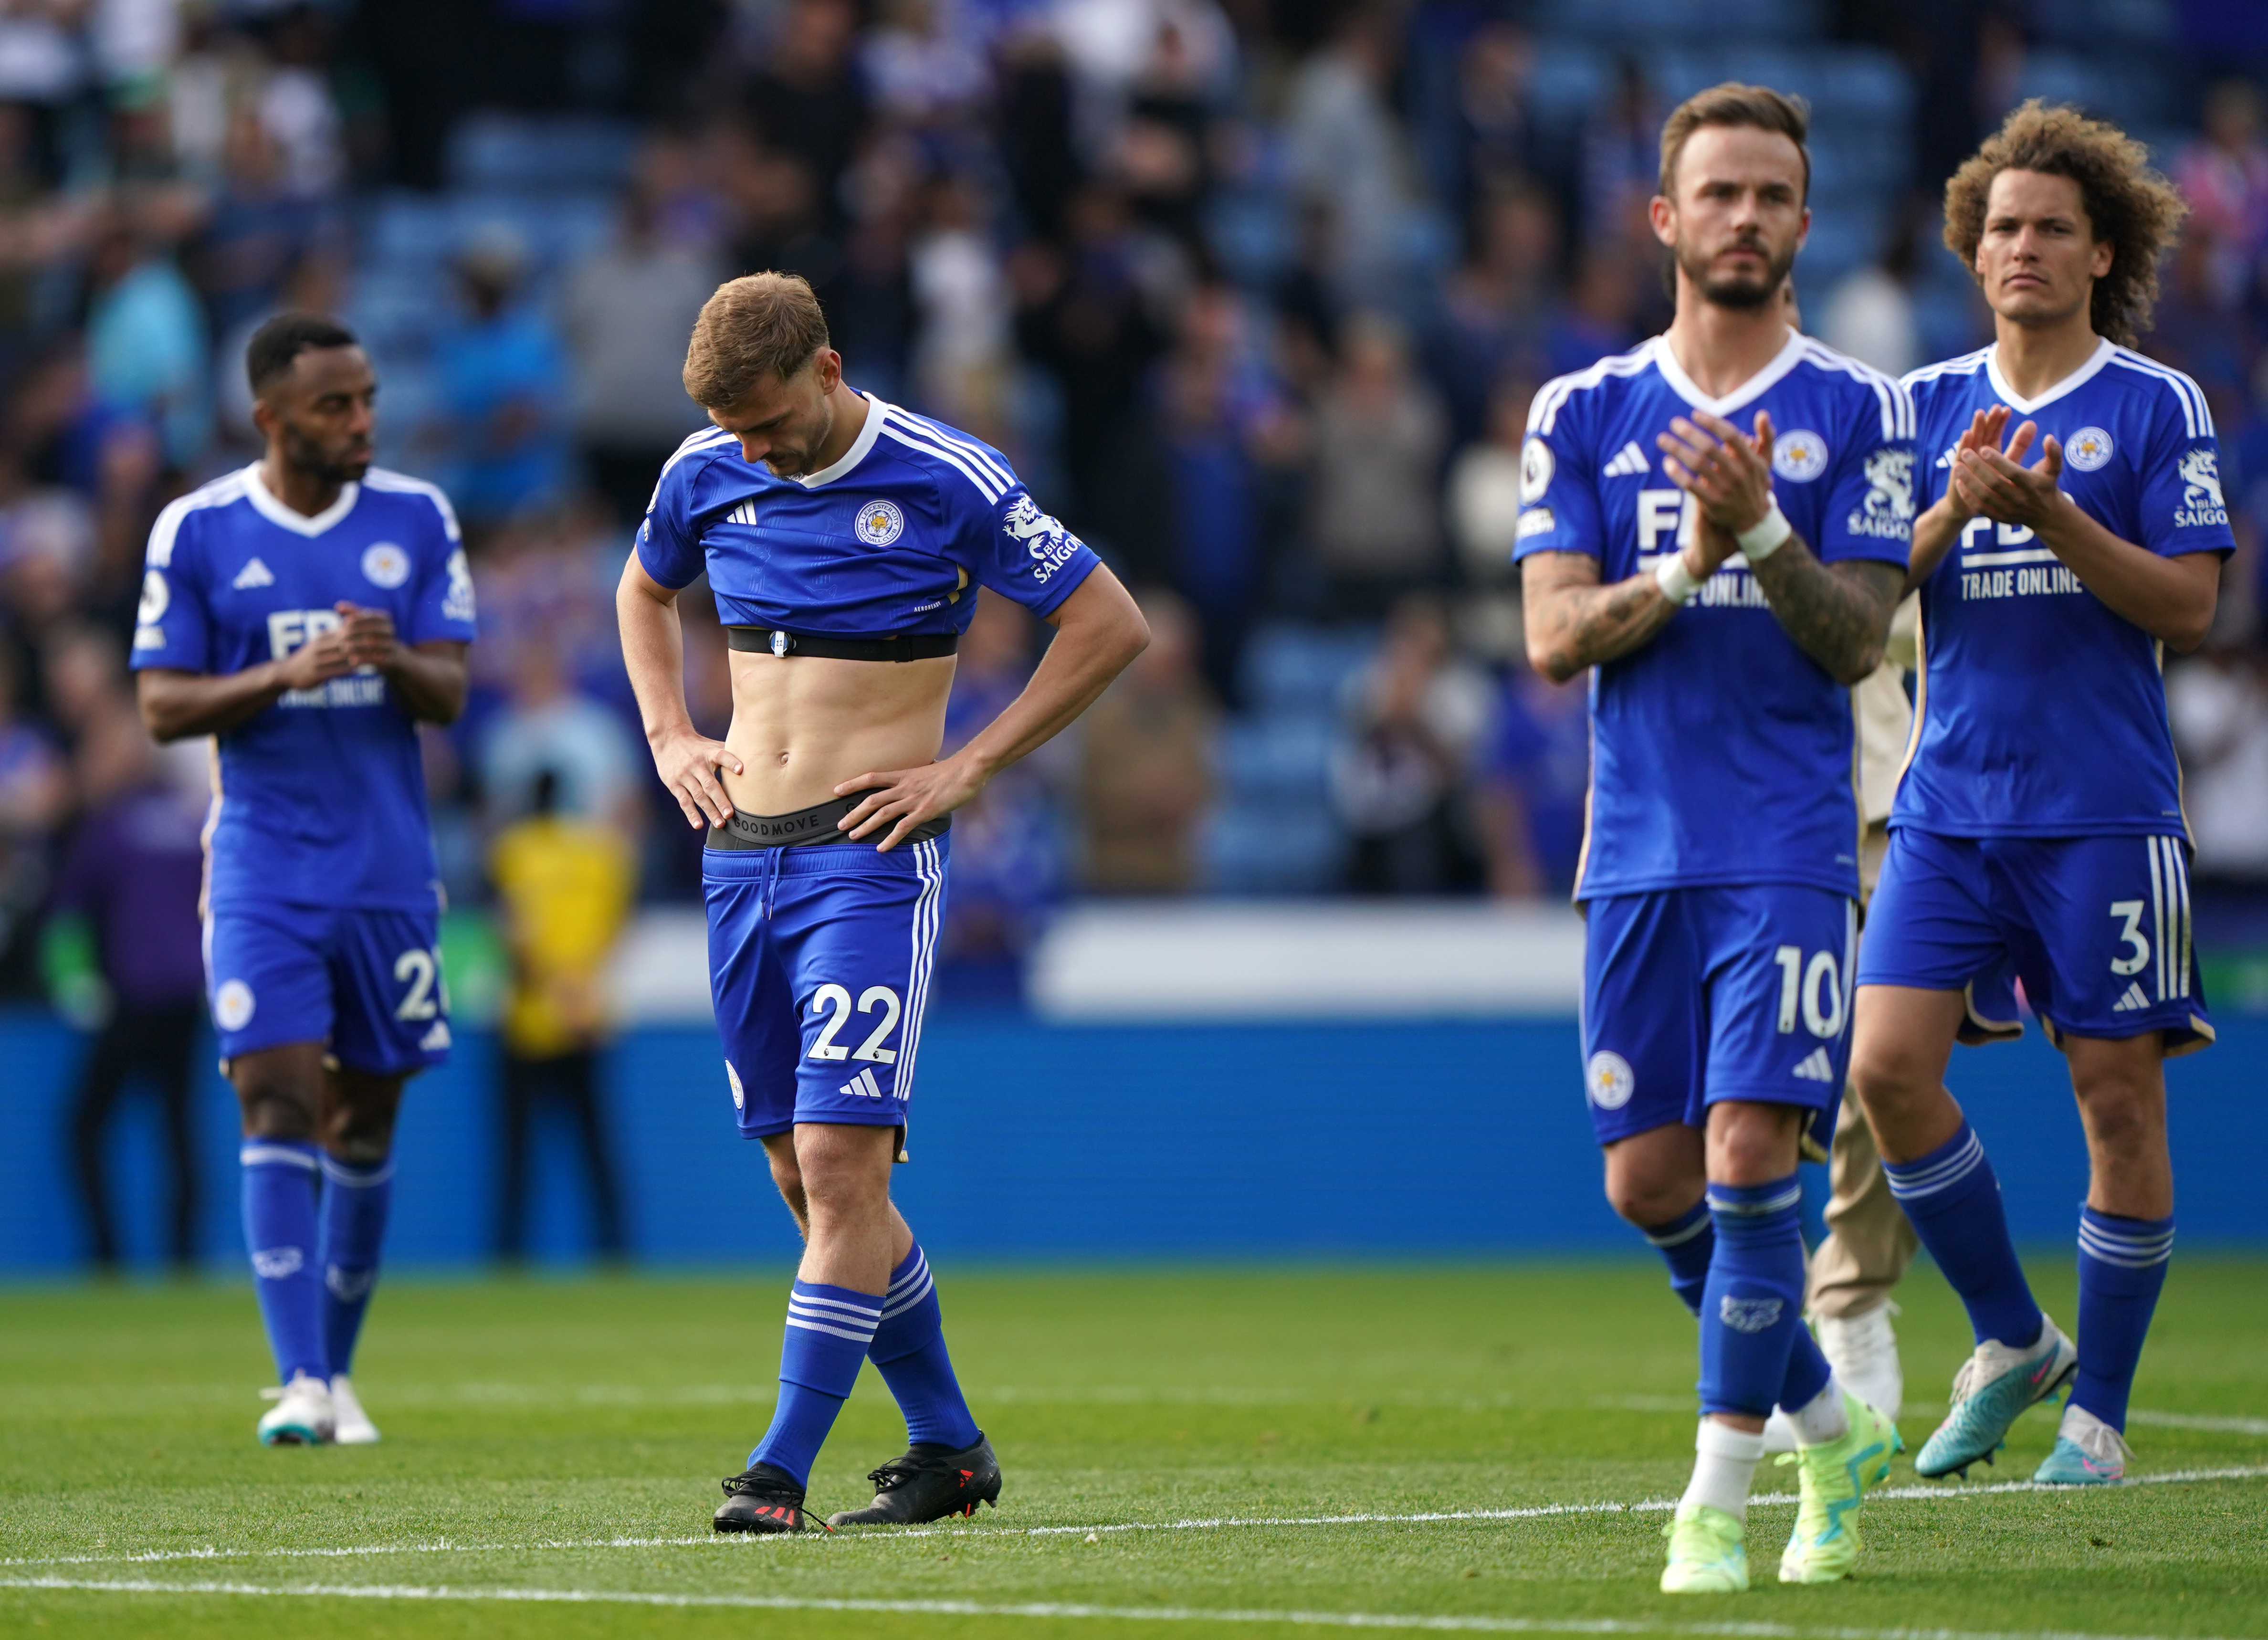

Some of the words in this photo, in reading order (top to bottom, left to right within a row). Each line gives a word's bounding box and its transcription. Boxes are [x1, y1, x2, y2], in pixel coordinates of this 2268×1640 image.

[861, 504, 892, 520] LEICESTER
[2174, 509, 2228, 528] SAIGO
[860, 523, 882, 543] FOOTBALL
[882, 528, 897, 542] CLUB
[1034, 534, 1083, 584] SAIGON
[1043, 537, 1063, 556] BIA
[1700, 573, 1772, 609] ONLIN
[1961, 570, 2014, 601] TRADE
[914, 600, 941, 612] AEROREADY
[733, 814, 819, 835] GOODMOVE
[2110, 899, 2150, 976] 3
[1774, 945, 1843, 1039] 10
[807, 983, 901, 1064] 22
